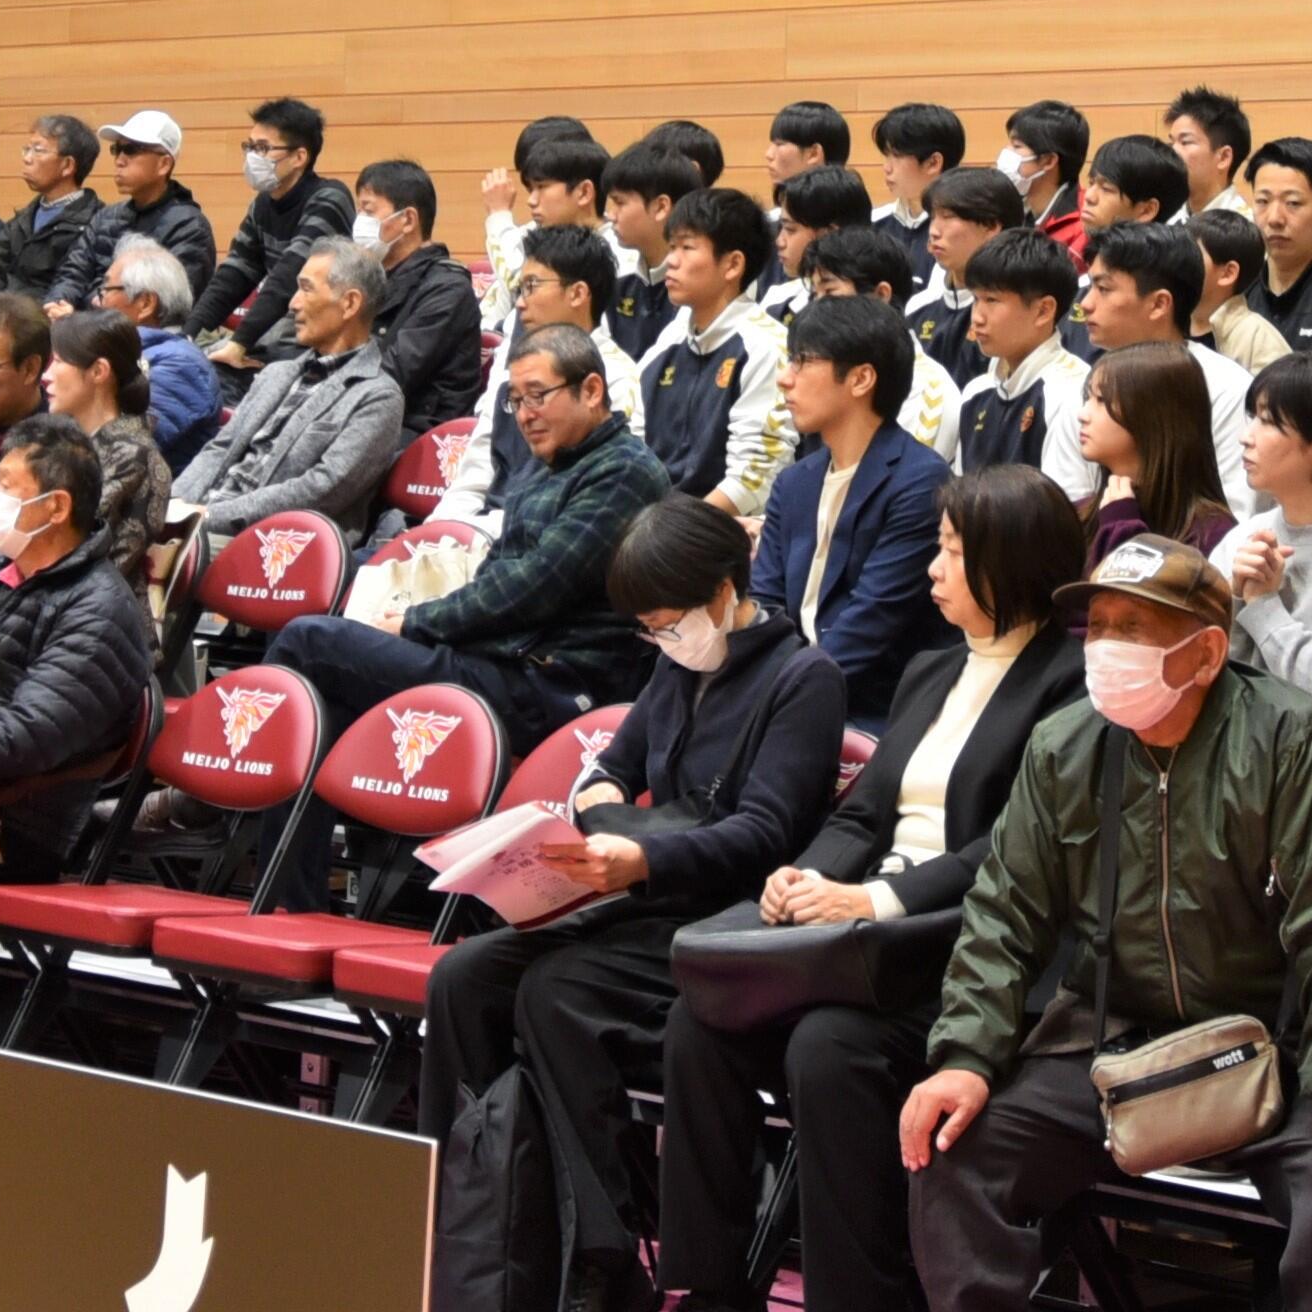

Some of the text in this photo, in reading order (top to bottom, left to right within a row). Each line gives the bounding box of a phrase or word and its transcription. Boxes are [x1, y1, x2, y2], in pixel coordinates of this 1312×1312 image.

[406, 484, 445, 496] MEIJO
[227, 585, 306, 601] MEIJO LIONS
[182, 751, 273, 776] MEIJO LIONS
[351, 775, 450, 802] MEIJO LIONS
